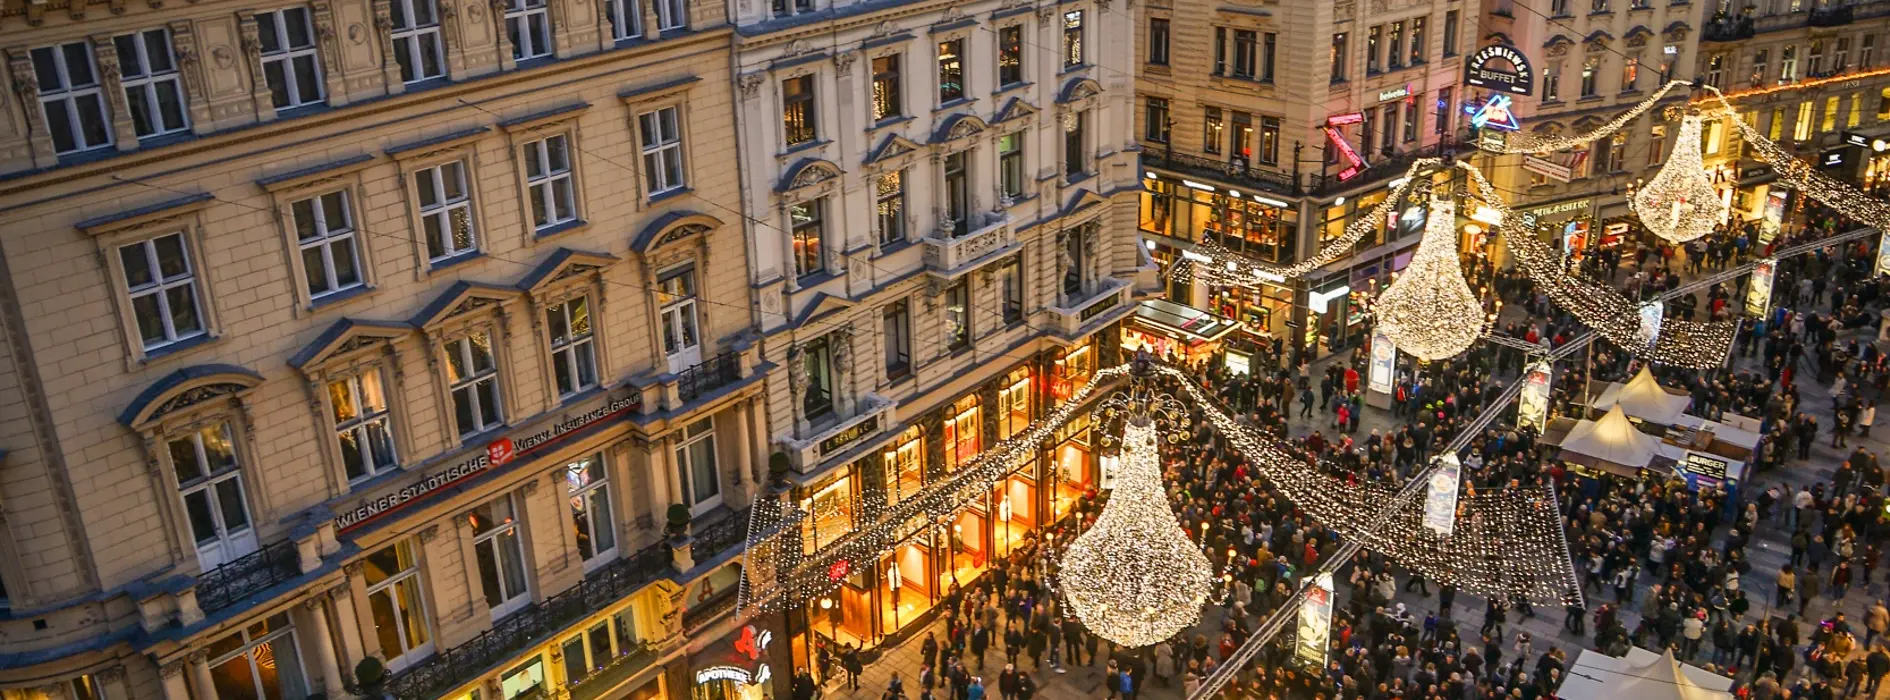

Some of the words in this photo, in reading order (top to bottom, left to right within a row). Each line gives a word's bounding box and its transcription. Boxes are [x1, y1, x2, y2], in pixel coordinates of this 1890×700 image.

[1480, 69, 1516, 84] BUFFET
[1689, 455, 1726, 470] BURGER
[336, 494, 399, 529] WIENER
[697, 666, 750, 684] APOTHEKE
